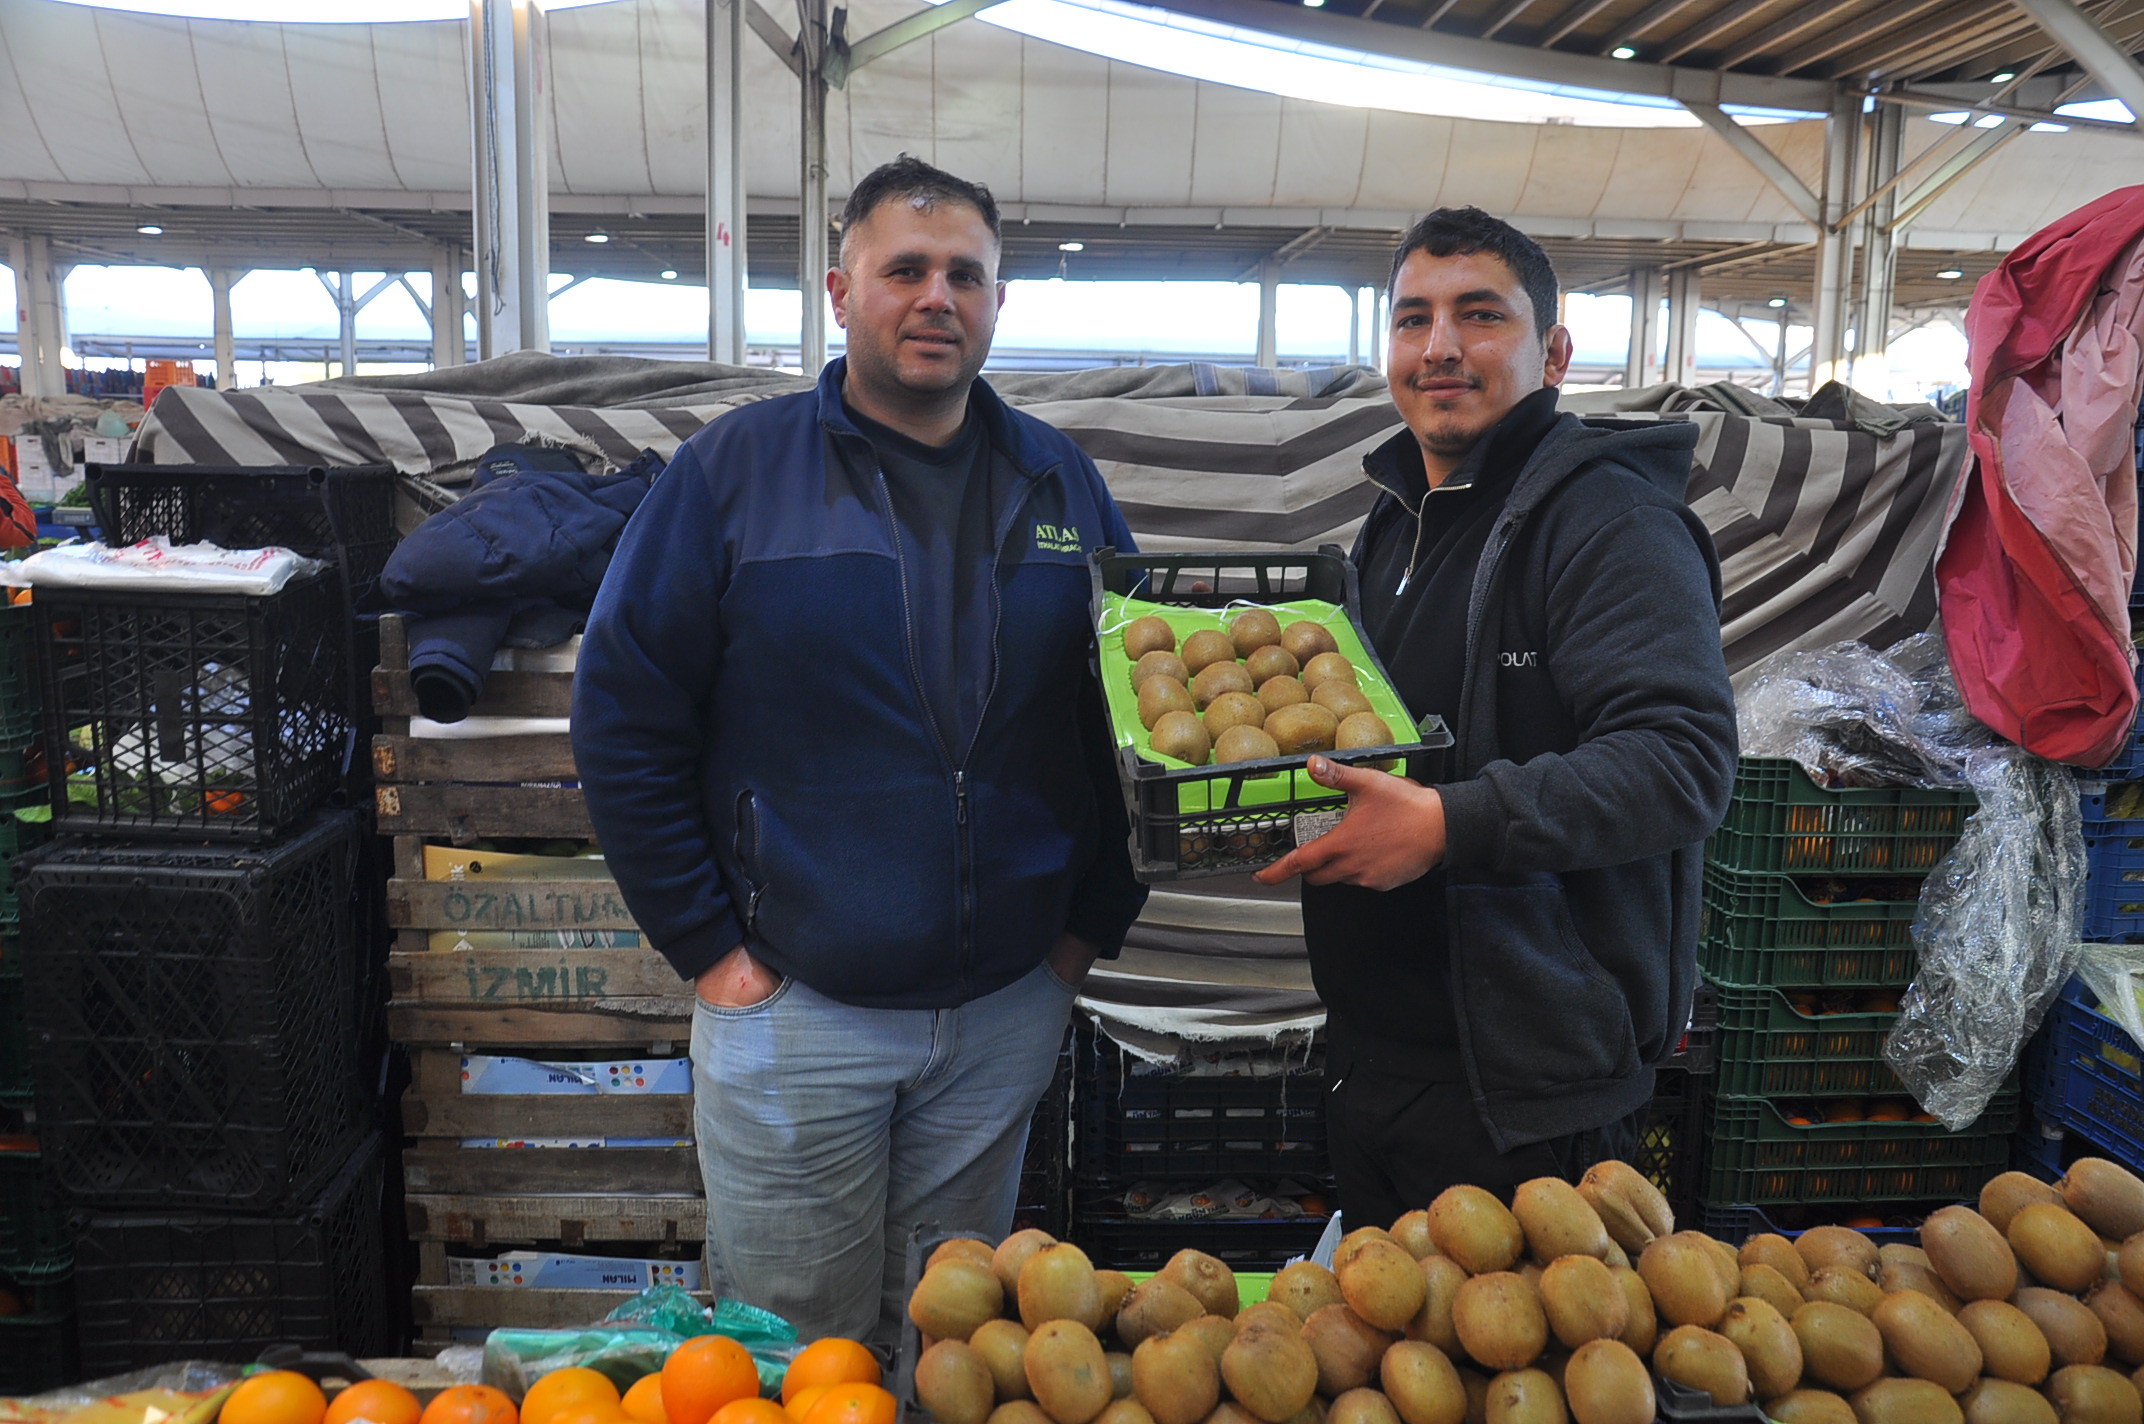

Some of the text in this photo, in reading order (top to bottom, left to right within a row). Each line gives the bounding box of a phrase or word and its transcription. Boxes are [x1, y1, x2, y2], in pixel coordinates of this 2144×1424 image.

[1036, 524, 1079, 542] ATLAS
[1498, 651, 1537, 667] OLAT
[463, 957, 608, 1001] İZMİR
[549, 1073, 583, 1084] MILAN
[602, 1274, 637, 1284] MILAN
